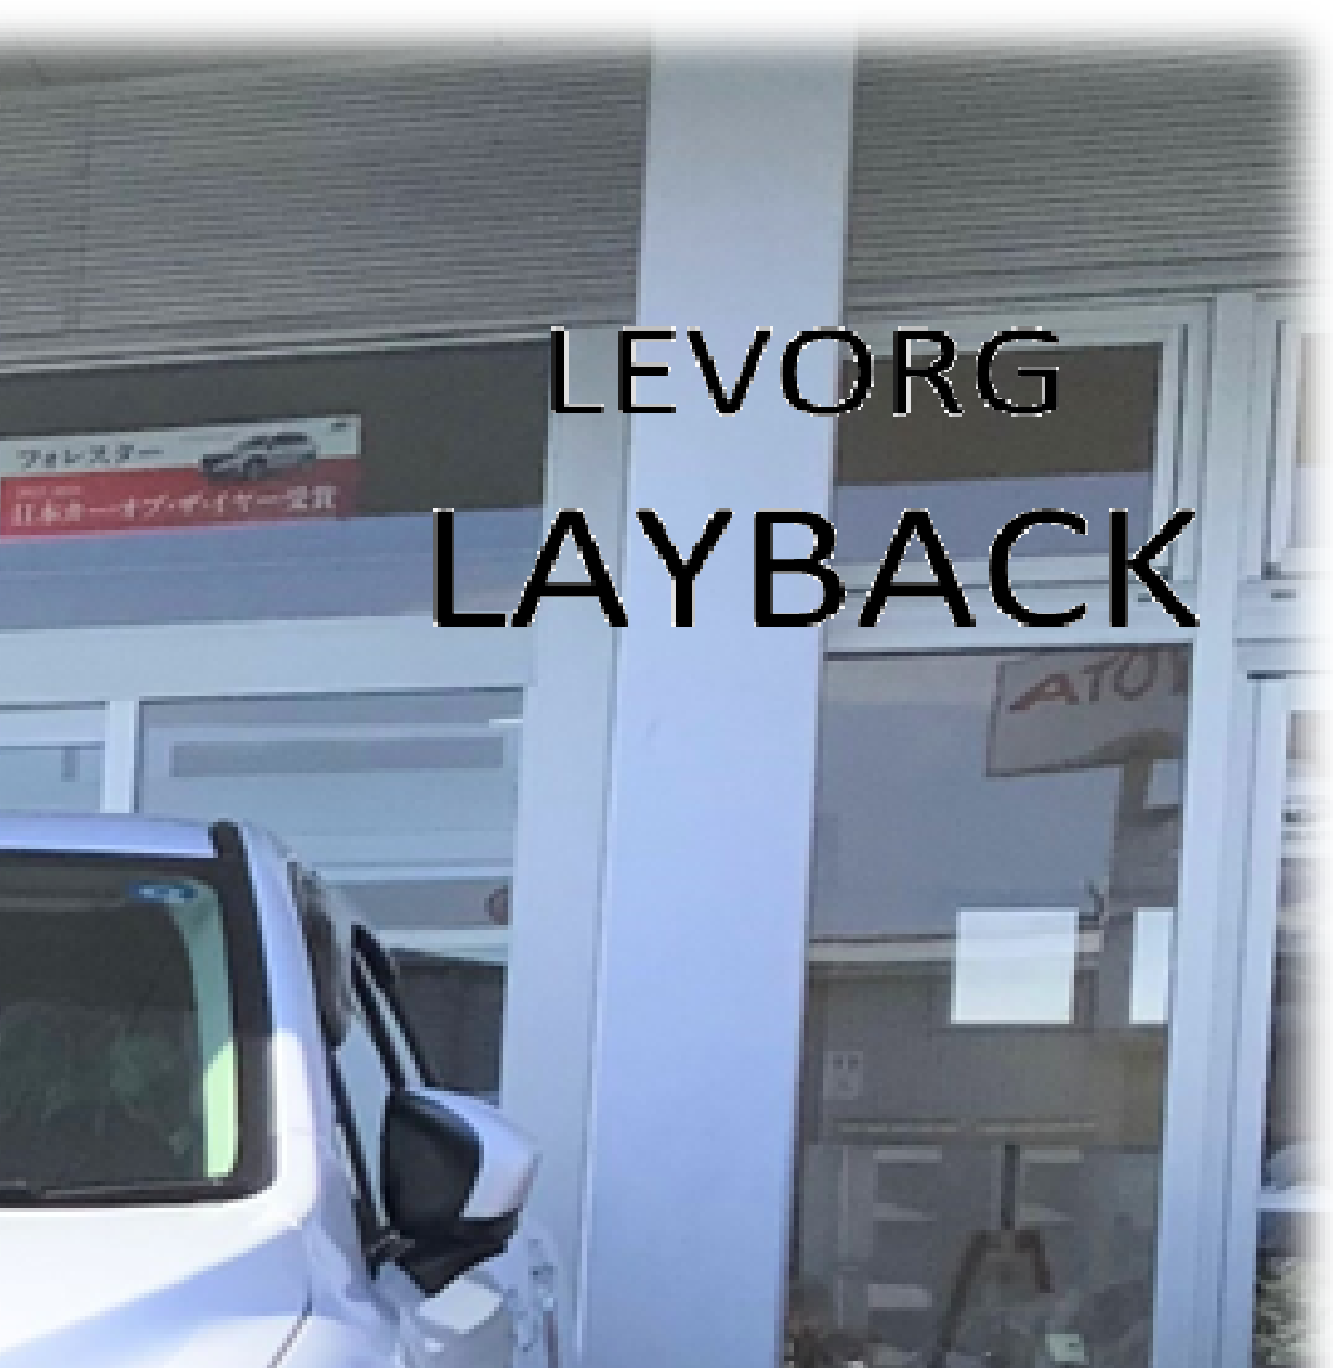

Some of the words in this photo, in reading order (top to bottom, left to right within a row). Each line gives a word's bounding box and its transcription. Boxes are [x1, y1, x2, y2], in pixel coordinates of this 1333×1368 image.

[16, 441, 165, 469] フォレスター
